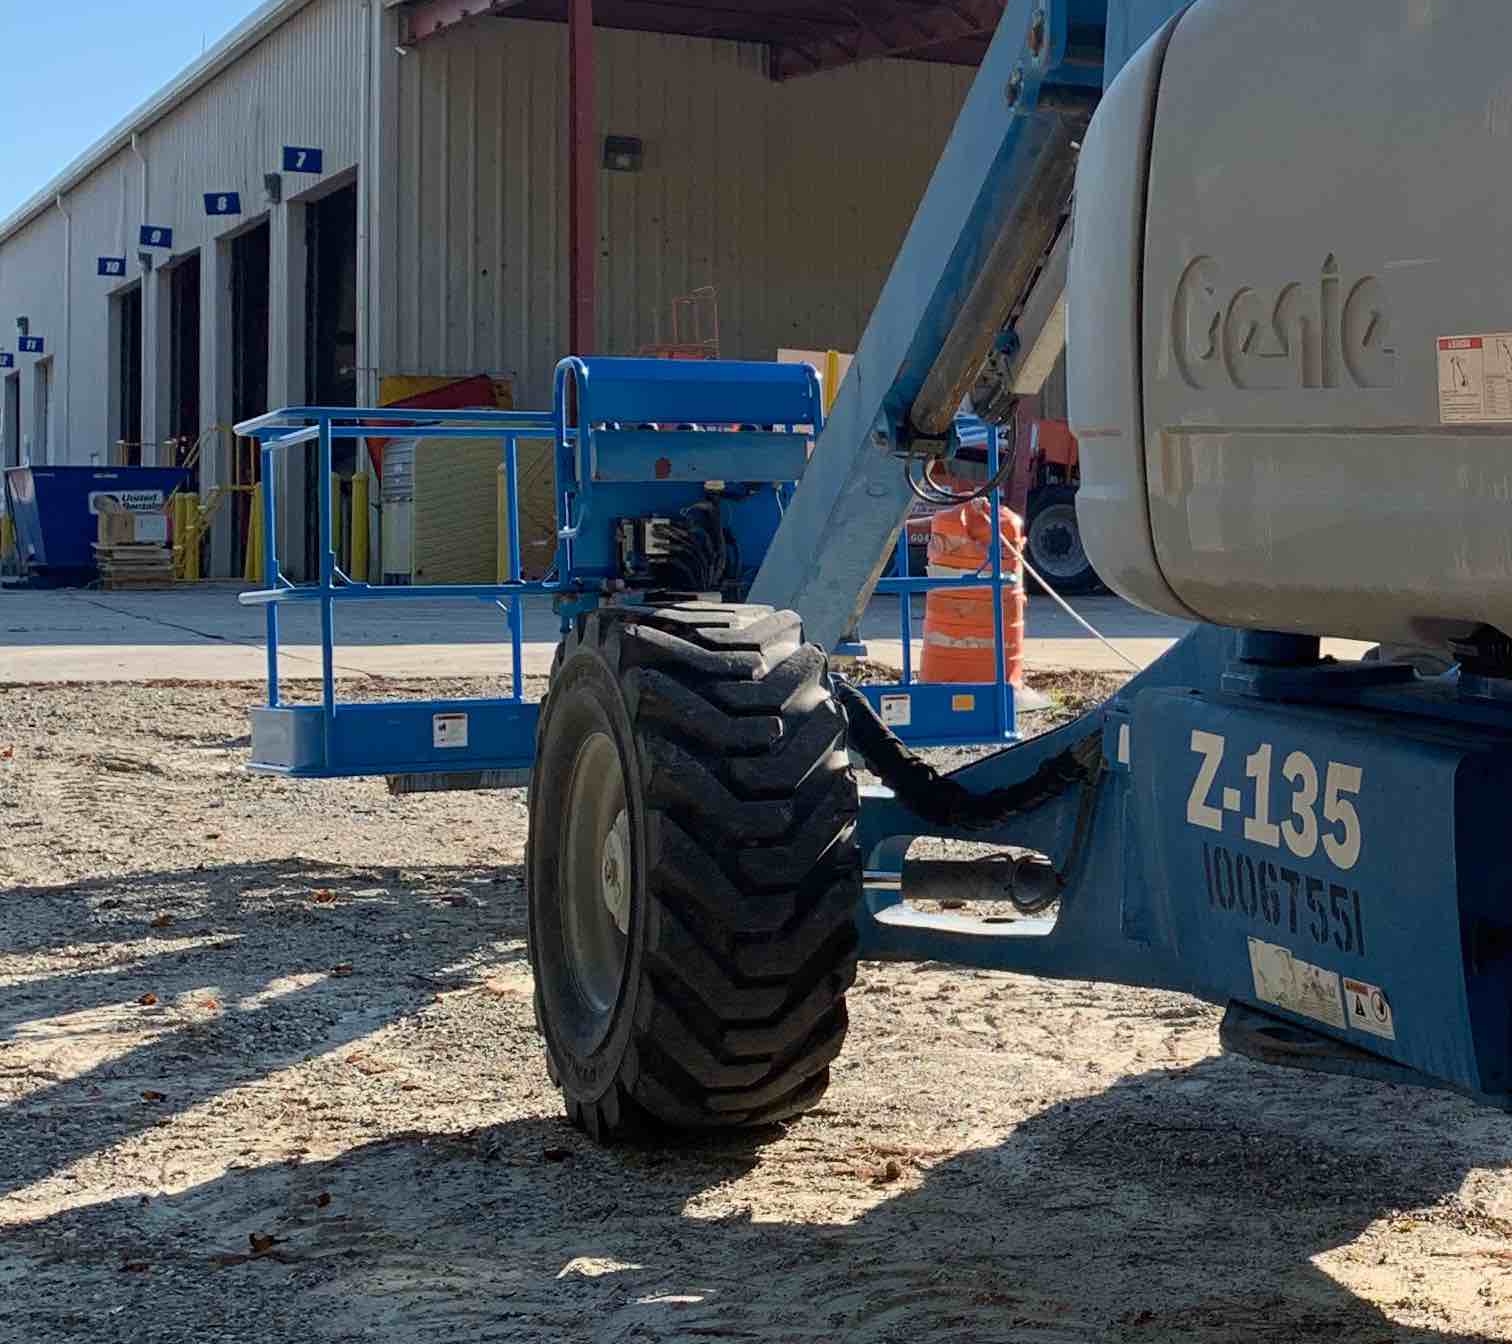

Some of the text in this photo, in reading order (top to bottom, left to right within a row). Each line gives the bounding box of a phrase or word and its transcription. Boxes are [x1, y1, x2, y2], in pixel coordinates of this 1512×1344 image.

[296, 151, 307, 168] 7
[105, 261, 119, 273] 10
[1170, 252, 1399, 391] Genie
[1186, 728, 1364, 871] Z-135
